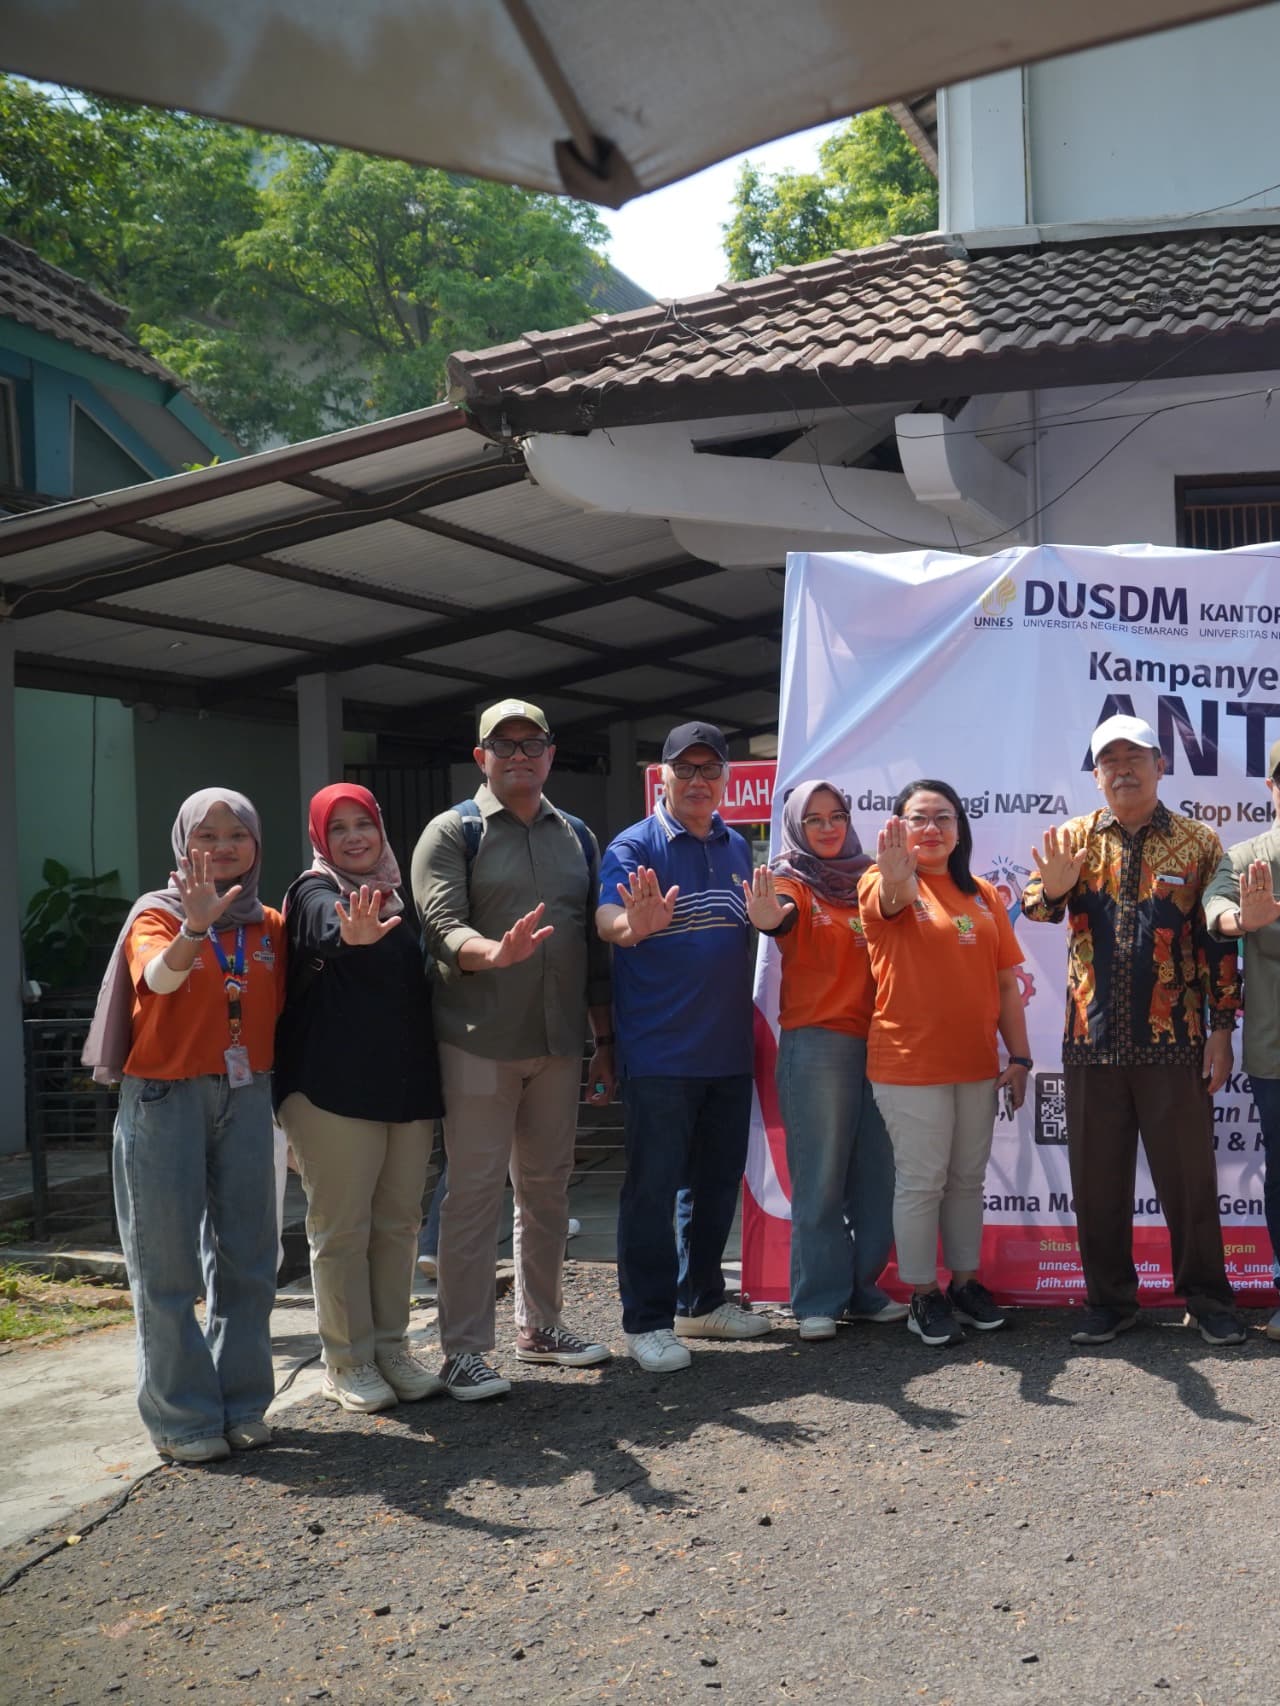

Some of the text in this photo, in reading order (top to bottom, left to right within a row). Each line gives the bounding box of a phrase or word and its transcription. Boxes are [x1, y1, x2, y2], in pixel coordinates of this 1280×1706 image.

[1024, 579, 1189, 625] DUSDM
[974, 616, 1013, 627] UNNES
[1023, 619, 1189, 636] UNIVERSITAS NEGERI SEMARANG
[1199, 628, 1268, 640] UNIVERSITAS
[1089, 651, 1278, 697] Kampanye
[995, 793, 1069, 815] NAPZA
[1179, 800, 1232, 827] Stop
[1039, 1239, 1072, 1252] Situs
